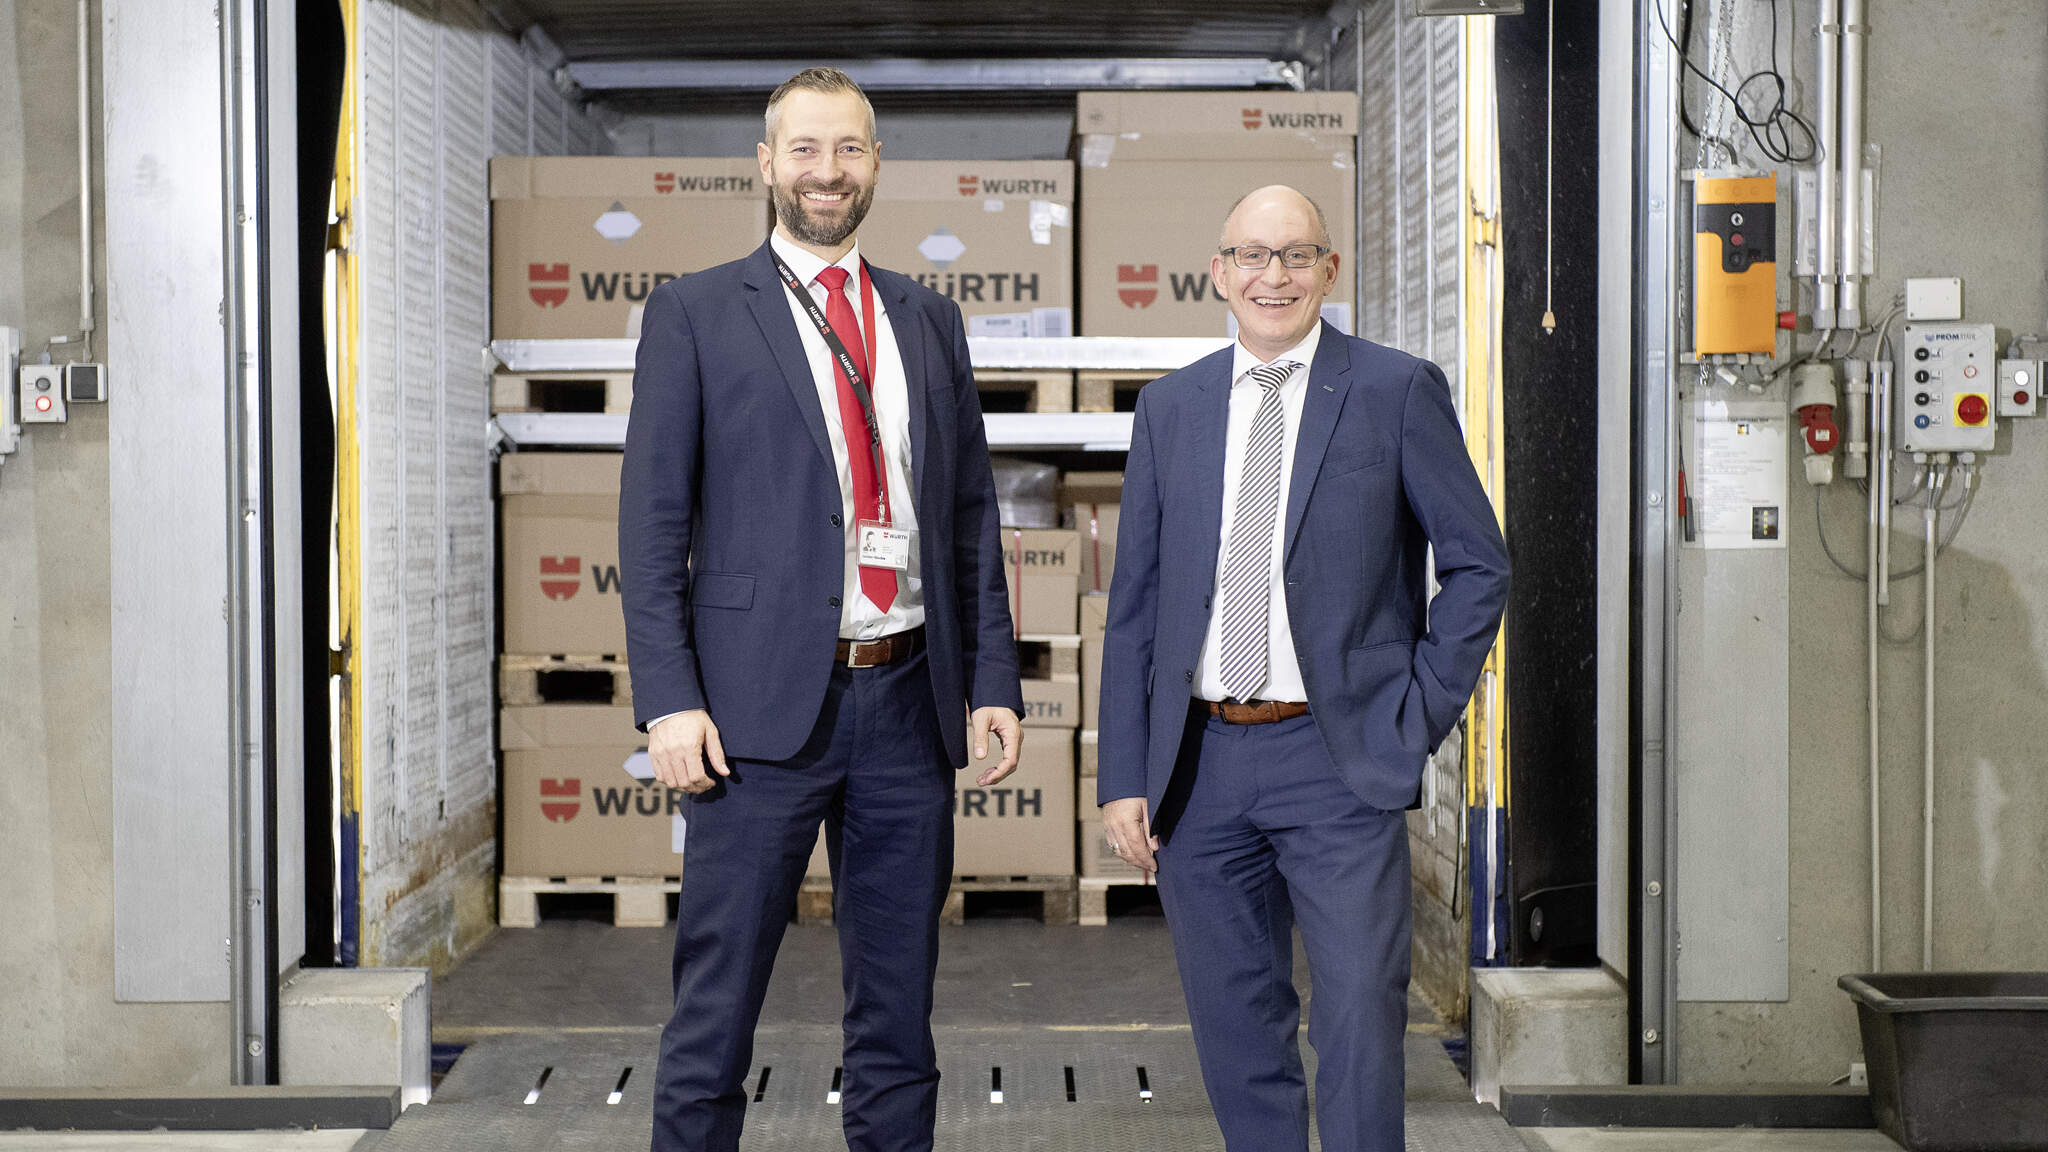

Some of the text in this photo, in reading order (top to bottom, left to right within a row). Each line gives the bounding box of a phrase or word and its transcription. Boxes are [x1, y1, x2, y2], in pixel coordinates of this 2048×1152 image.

[1268, 112, 1343, 129] WÜRTH
[679, 176, 753, 192] WÜRTH
[983, 179, 1056, 194] WÜRTH
[778, 264, 794, 282] WÜRTH
[917, 272, 1038, 302] ÜRTH
[809, 305, 826, 328] WÜRTH
[839, 353, 856, 377] WÜRTH
[953, 788, 1041, 816] RTH
